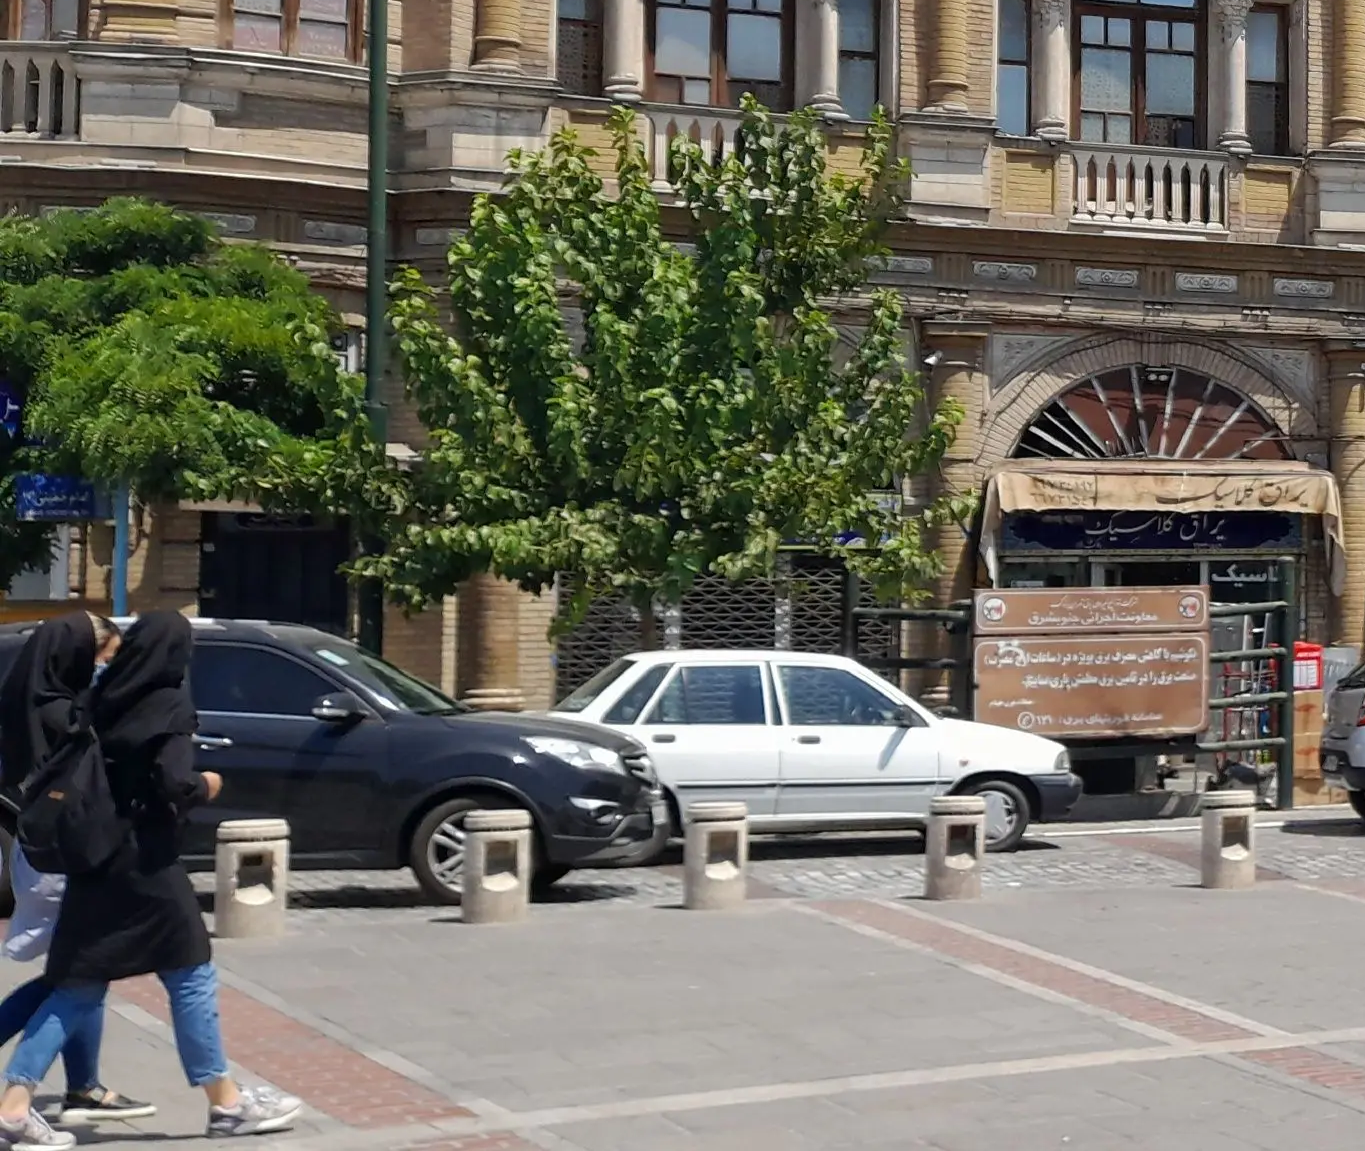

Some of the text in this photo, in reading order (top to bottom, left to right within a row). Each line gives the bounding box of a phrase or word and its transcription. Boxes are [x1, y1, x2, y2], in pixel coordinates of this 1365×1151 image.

[1154, 477, 1309, 509] یراق کلاسیک
[1084, 510, 1227, 541] یراق کلاسیک
[1115, 612, 1158, 626] معاونت
[1062, 653, 1072, 666] در
[1095, 651, 1111, 665] برق
[1112, 649, 1137, 664] مصرف
[1138, 647, 1163, 663] کاهش
